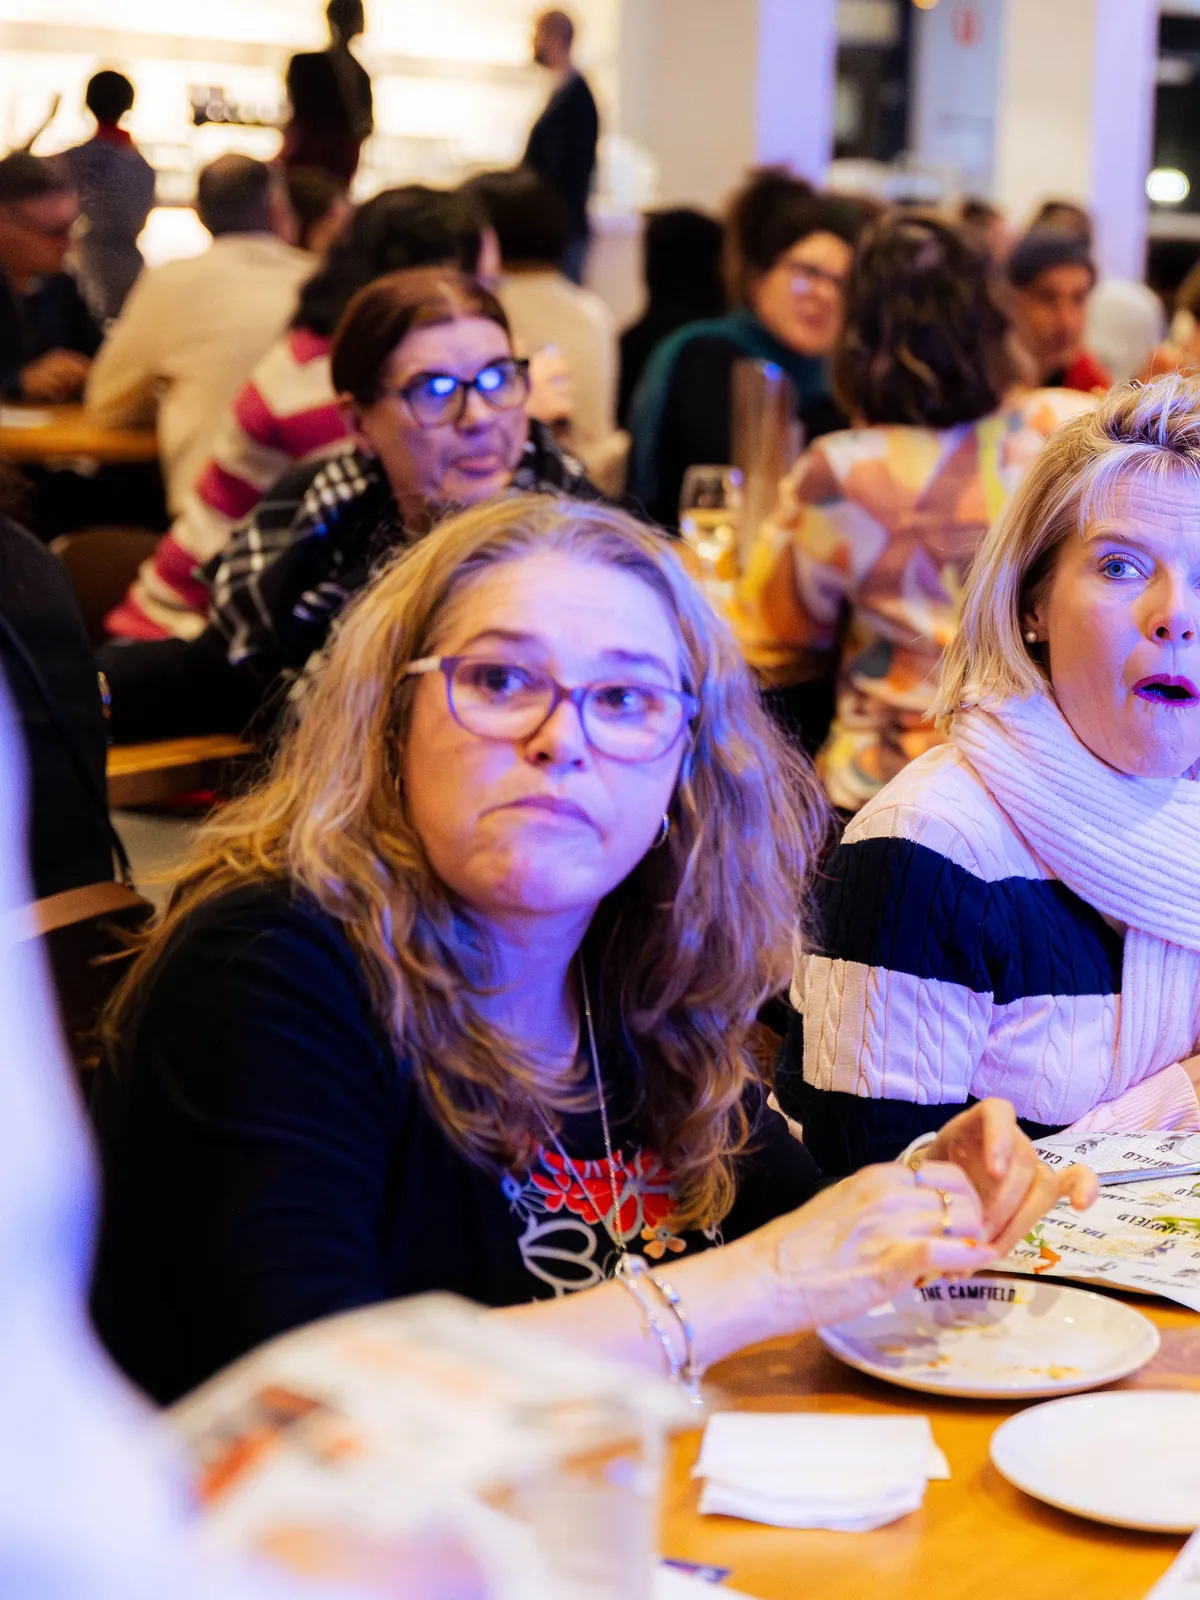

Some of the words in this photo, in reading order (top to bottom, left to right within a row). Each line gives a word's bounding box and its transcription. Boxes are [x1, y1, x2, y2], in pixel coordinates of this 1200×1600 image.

[1078, 1227, 1107, 1239] THE
[920, 1285, 943, 1302] THE
[947, 1285, 1016, 1302] CAMFIELD
